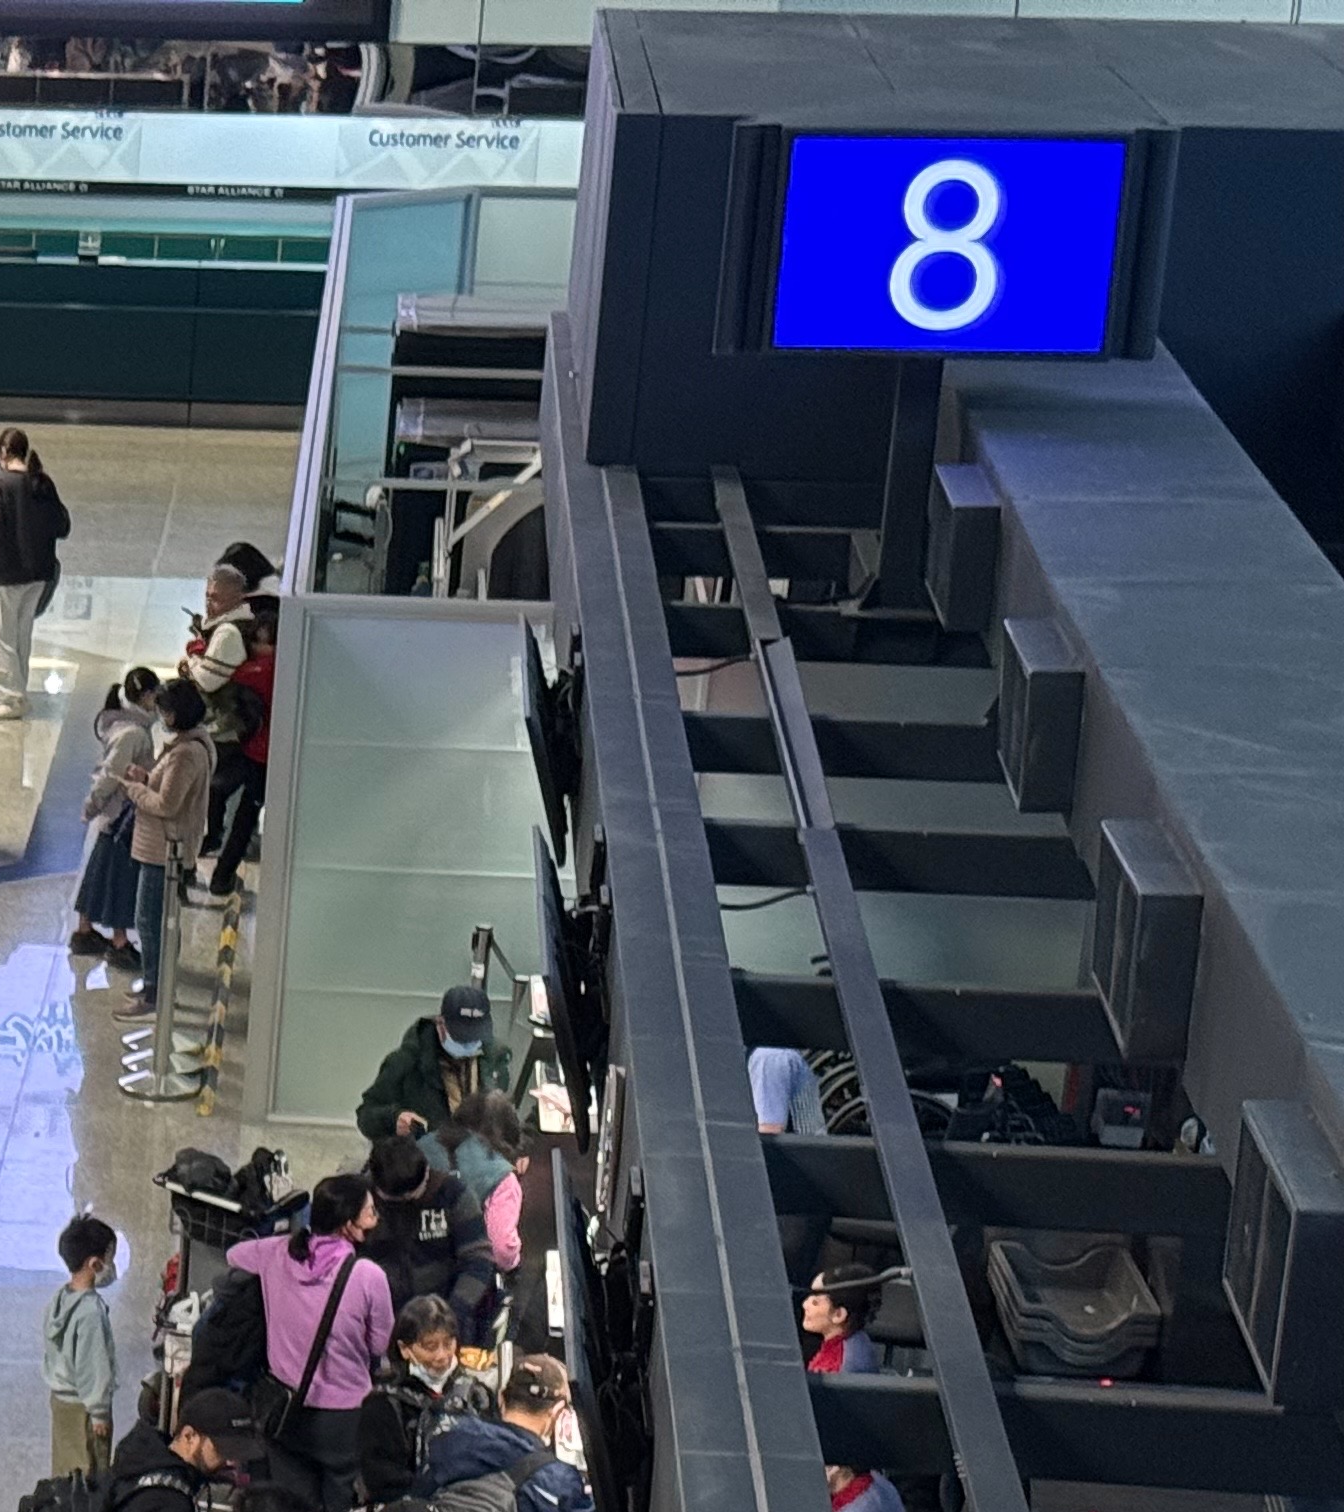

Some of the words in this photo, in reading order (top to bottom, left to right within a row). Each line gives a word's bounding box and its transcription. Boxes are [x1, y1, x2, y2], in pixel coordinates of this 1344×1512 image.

[61, 121, 124, 141] Service
[368, 129, 452, 149] Customer
[455, 131, 520, 151] Service
[888, 158, 1002, 332] 8
